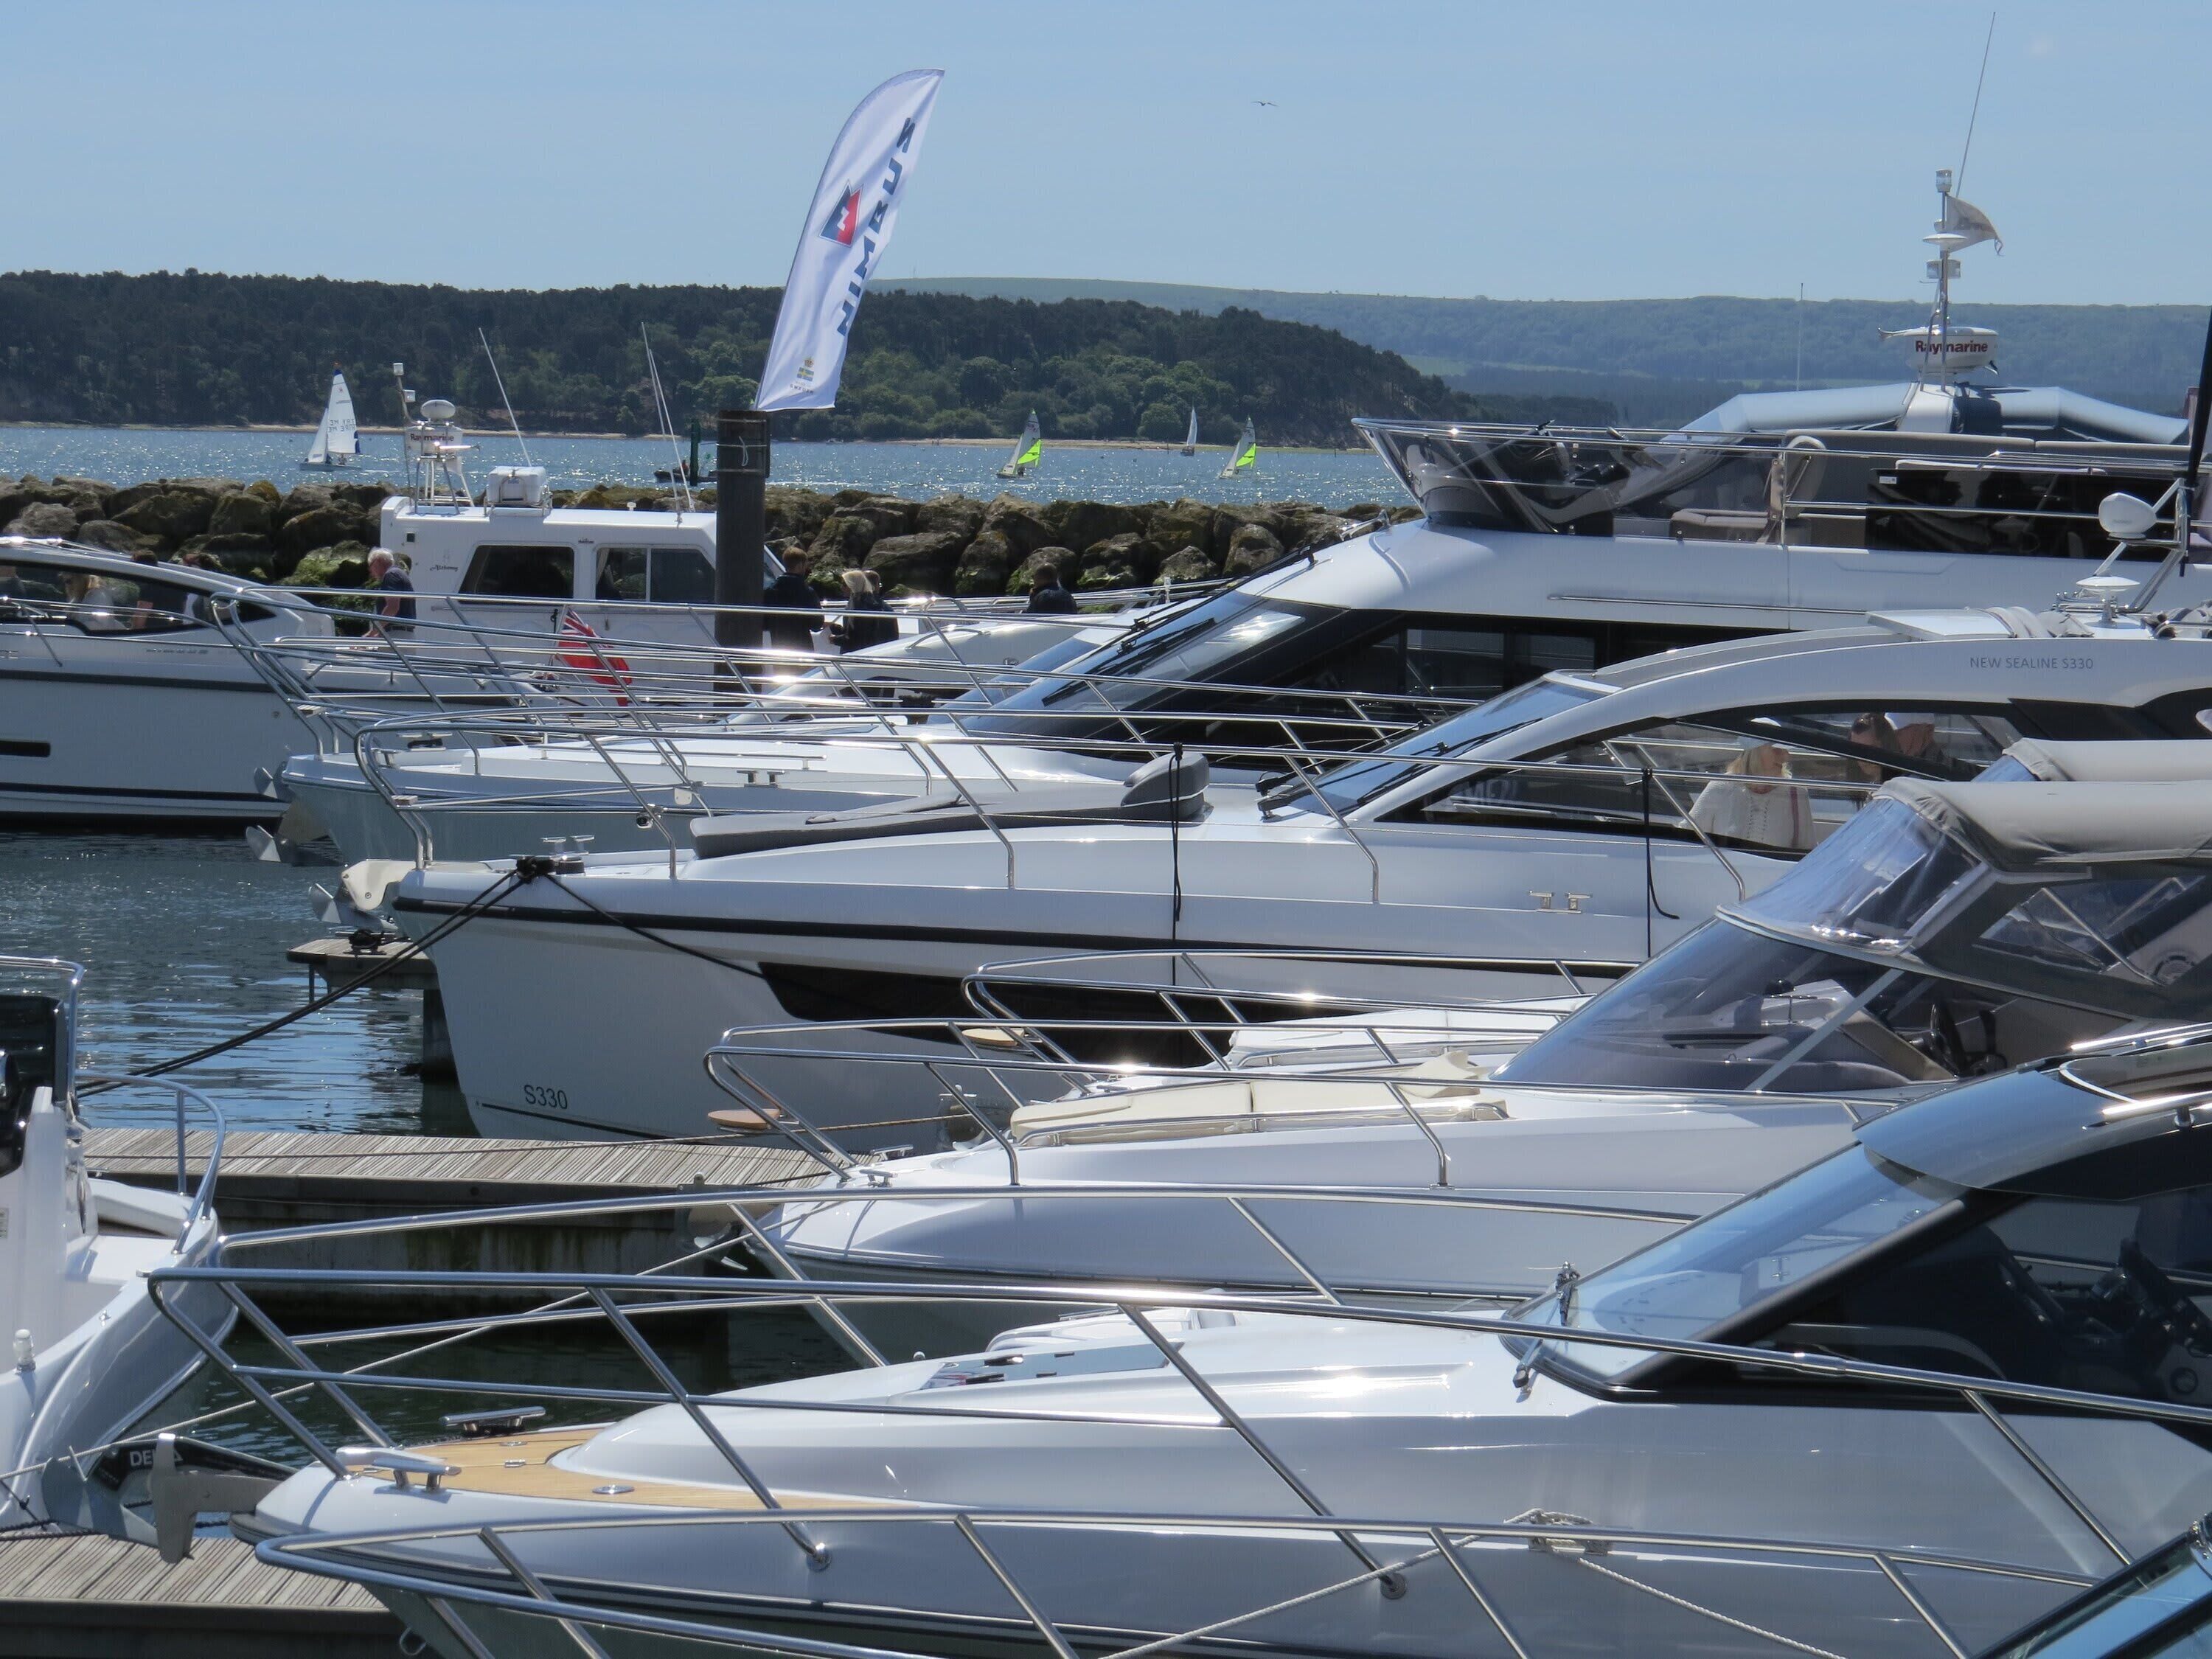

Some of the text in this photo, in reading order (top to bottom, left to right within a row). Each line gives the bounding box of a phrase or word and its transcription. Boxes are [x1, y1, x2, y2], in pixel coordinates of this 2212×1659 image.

[836, 117, 916, 337] NIMBUS
[1969, 657, 2093, 669] NEW SEALINE S330
[524, 1084, 568, 1110] S330
[129, 1449, 183, 1467] DEA
